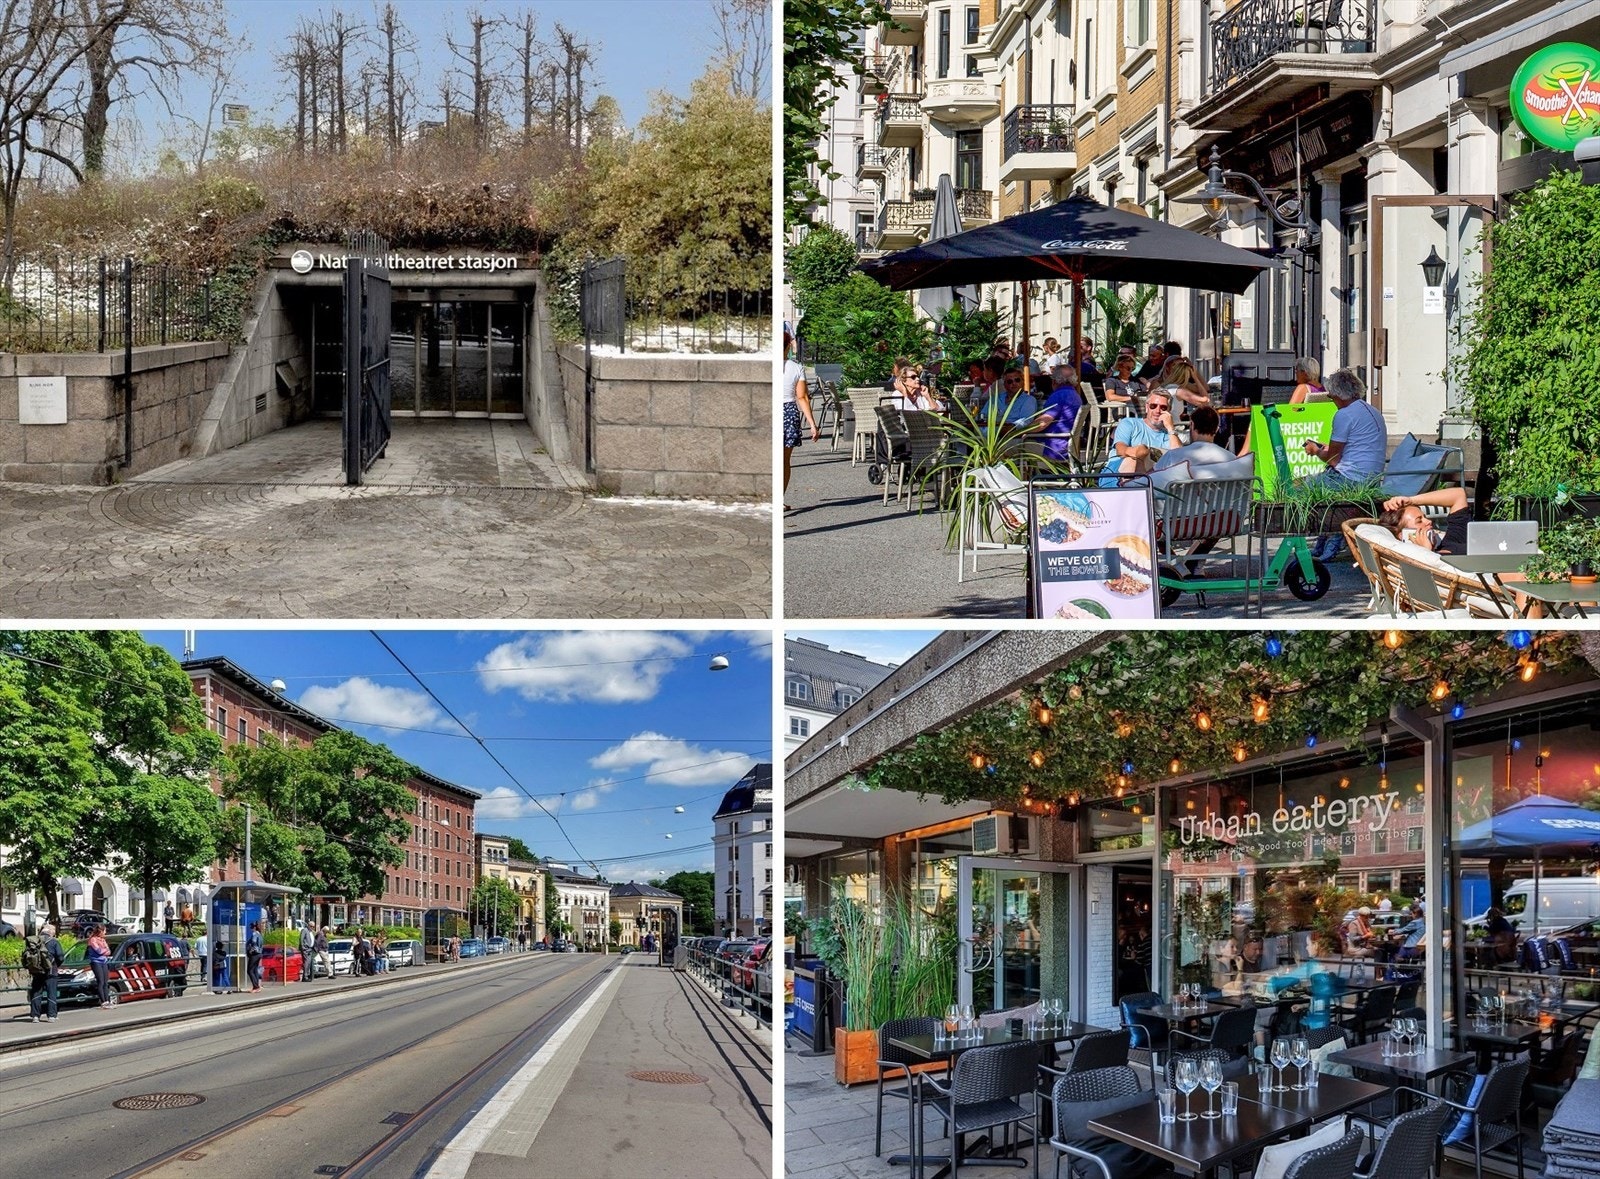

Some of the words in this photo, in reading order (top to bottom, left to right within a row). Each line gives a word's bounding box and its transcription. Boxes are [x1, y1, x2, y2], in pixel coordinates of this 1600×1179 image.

[458, 253, 518, 272] stasjon
[1280, 421, 1324, 436] FRESHLY
[1047, 556, 1080, 566] WE'VE
[1082, 555, 1103, 565] GOT
[1048, 566, 1070, 577] THE
[1071, 564, 1110, 576] BOWLS
[1178, 811, 1264, 845] Urban
[1272, 791, 1400, 833] eatery
[1258, 841, 1281, 855] good
[1285, 837, 1308, 849] food
[1313, 836, 1338, 847] meet
[1344, 831, 1371, 846] good
[1378, 828, 1416, 840] vibes
